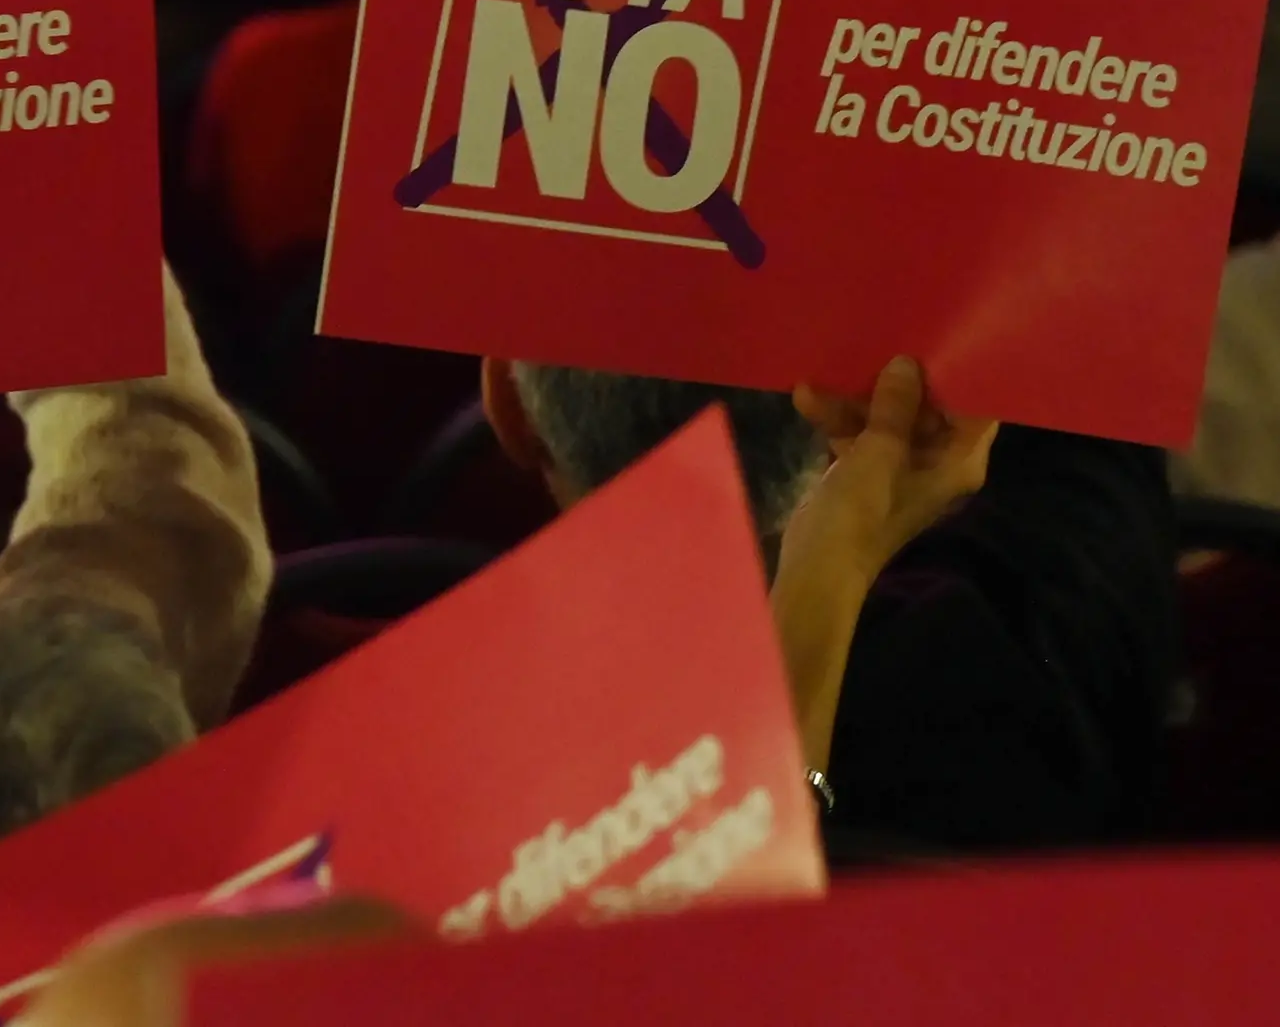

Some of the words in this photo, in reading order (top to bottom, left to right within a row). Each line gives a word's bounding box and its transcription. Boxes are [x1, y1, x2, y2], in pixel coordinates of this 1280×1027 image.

[819, 14, 920, 79] per
[923, 16, 1179, 110] difendere
[815, 74, 865, 137] la
[876, 85, 1209, 188] Costituzione
